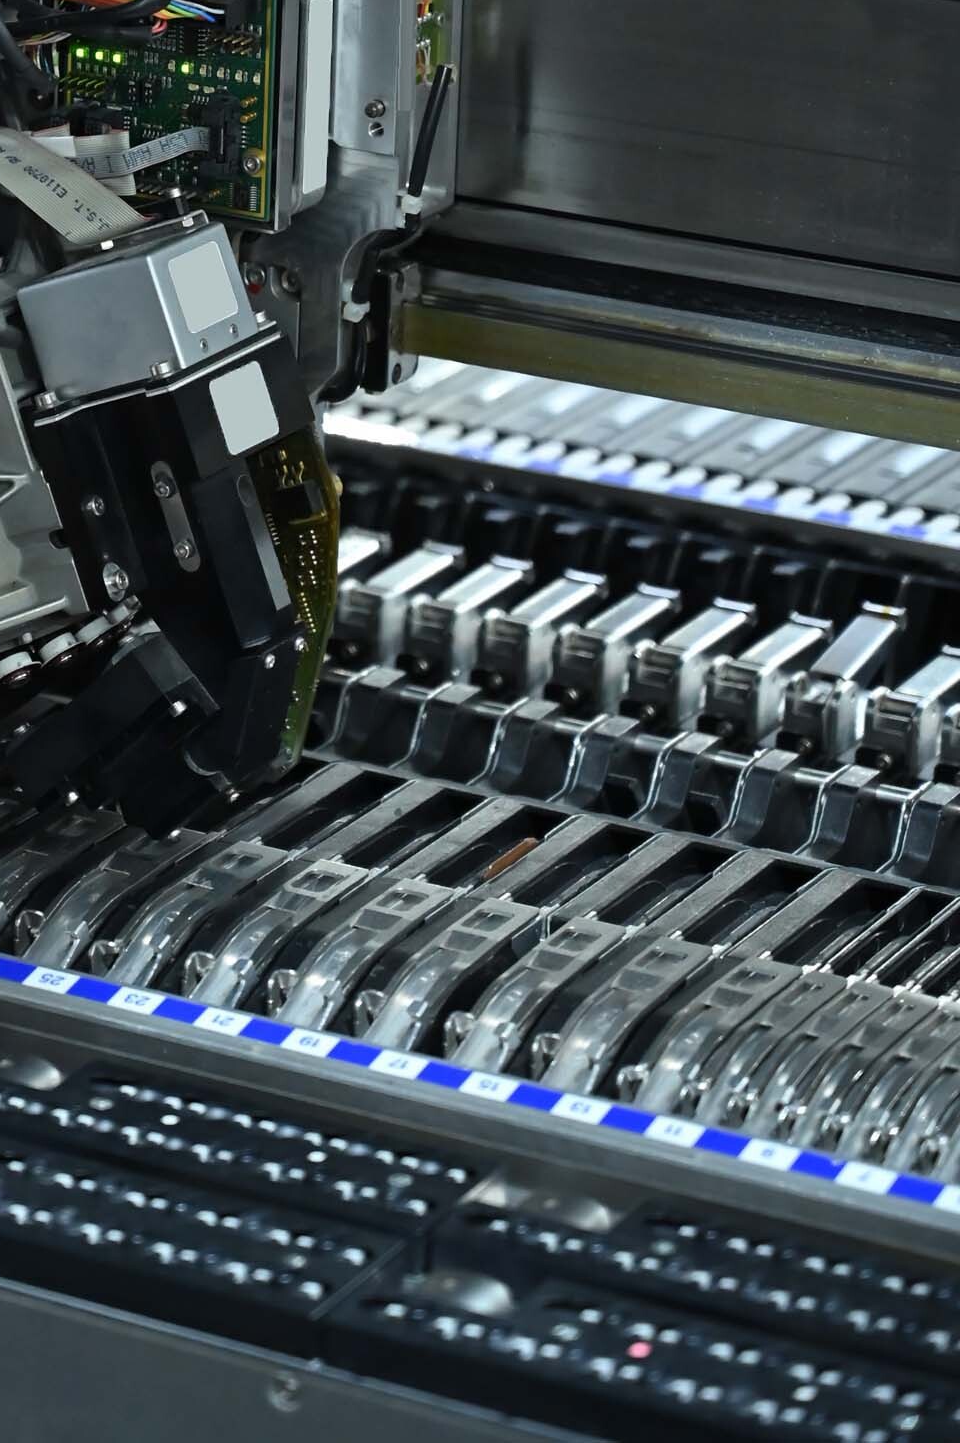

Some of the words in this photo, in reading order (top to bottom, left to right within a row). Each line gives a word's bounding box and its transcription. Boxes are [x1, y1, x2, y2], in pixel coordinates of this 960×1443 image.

[39, 973, 65, 986] 25
[124, 993, 151, 1006] 23
[211, 1015, 236, 1027] 21
[299, 1036, 319, 1047] 19
[389, 1058, 410, 1069] 17
